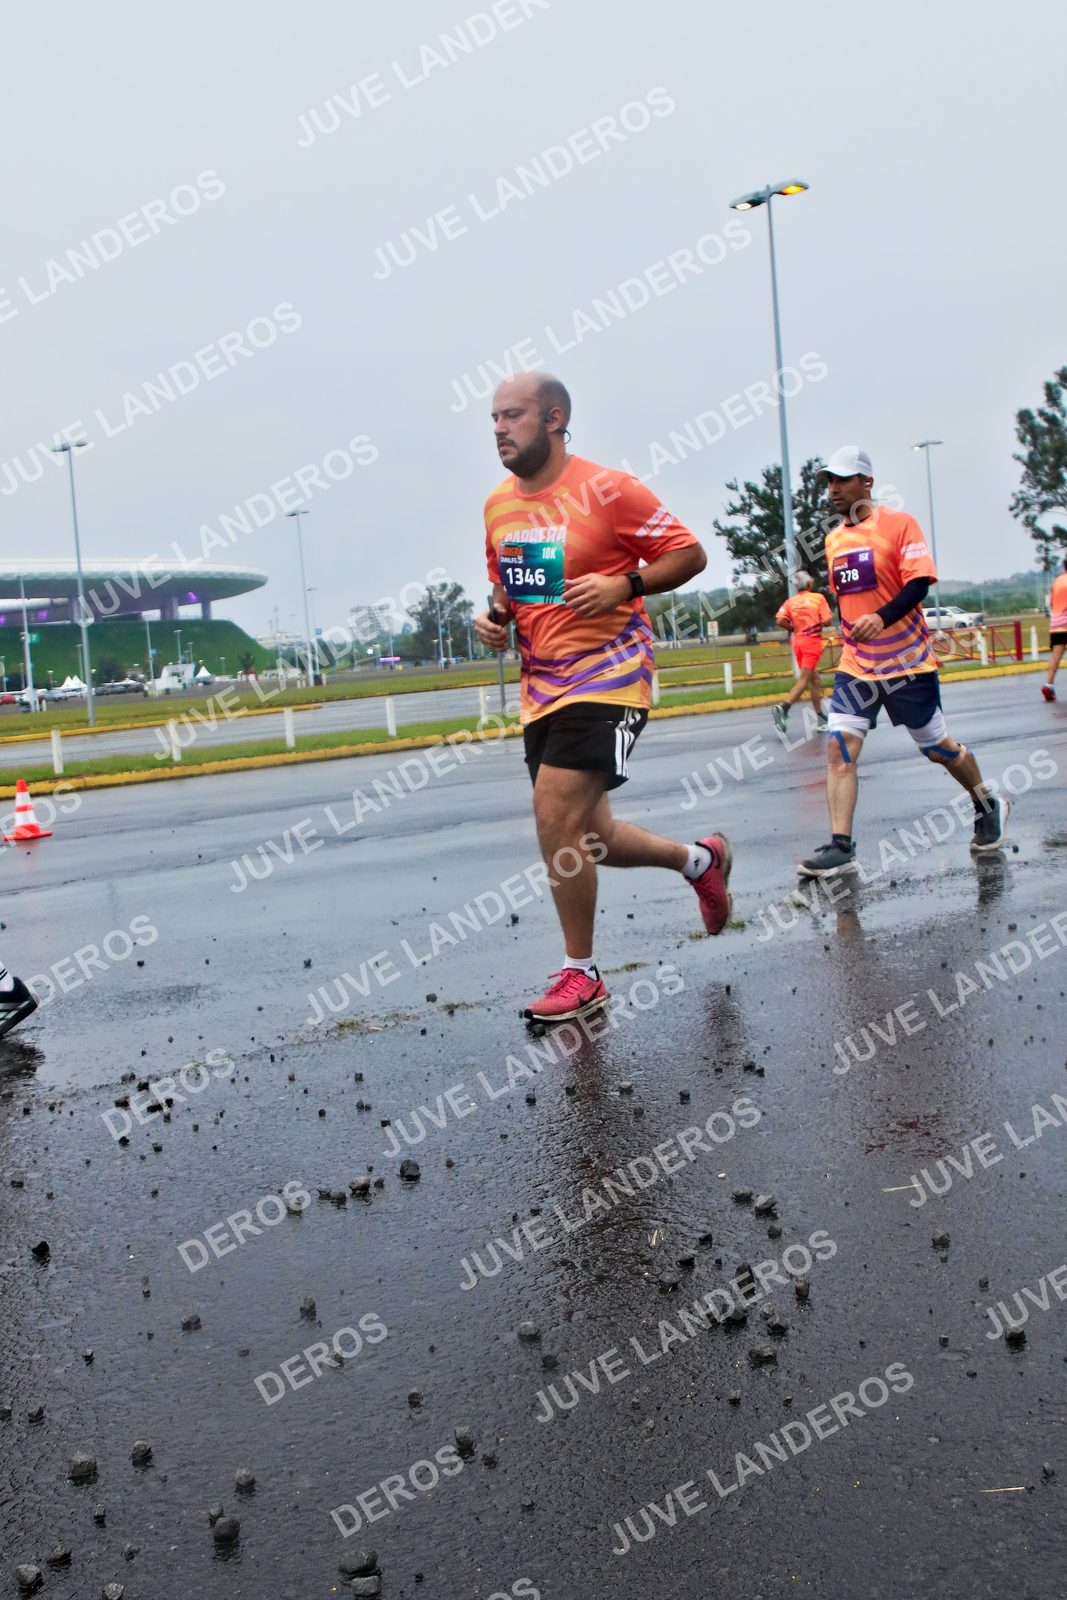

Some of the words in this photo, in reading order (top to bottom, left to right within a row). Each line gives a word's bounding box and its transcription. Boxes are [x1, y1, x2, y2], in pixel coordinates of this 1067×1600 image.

[542, 547, 556, 560] 10K
[506, 567, 546, 586] 1346
[840, 568, 859, 583] 278
